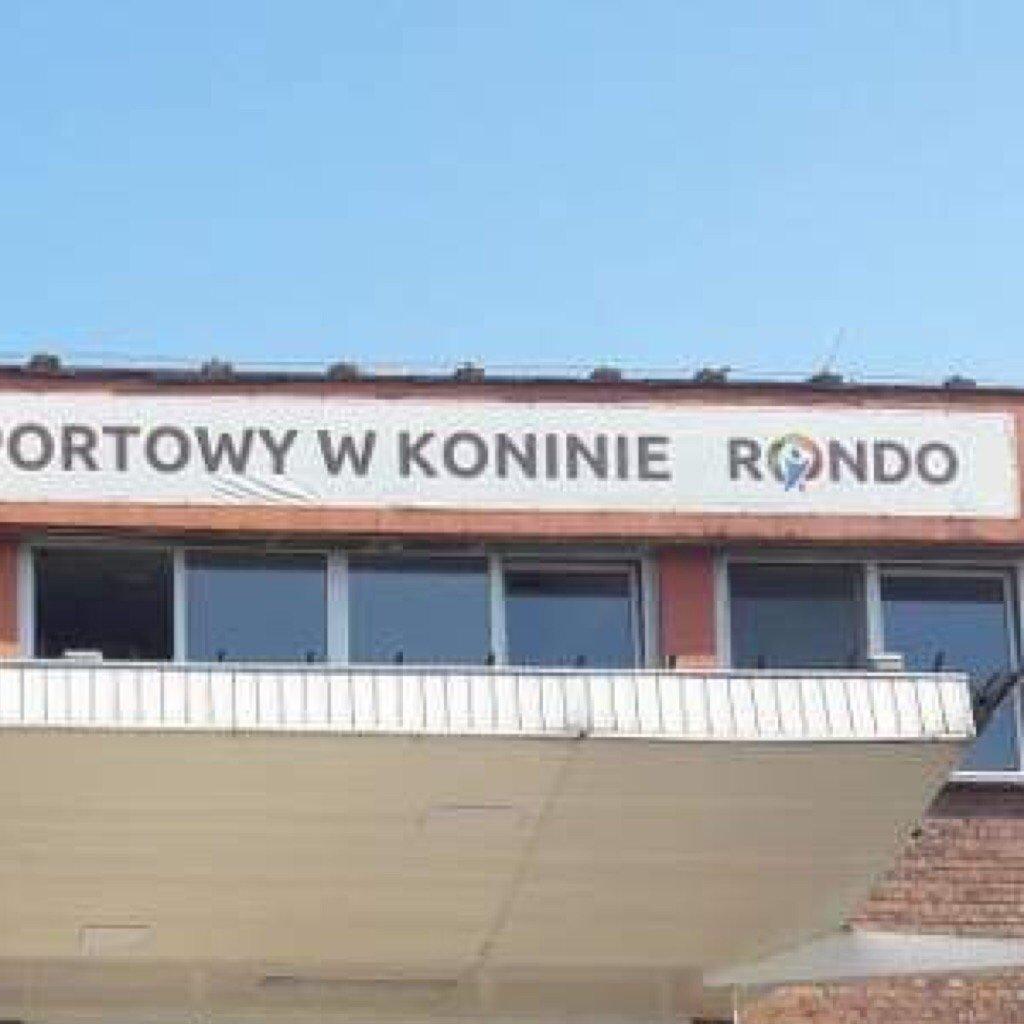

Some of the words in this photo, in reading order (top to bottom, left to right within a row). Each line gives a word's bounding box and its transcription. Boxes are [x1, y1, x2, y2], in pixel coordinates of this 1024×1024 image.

[317, 429, 376, 476] W
[399, 432, 671, 480] KONINIE
[729, 433, 958, 487] RONDO
